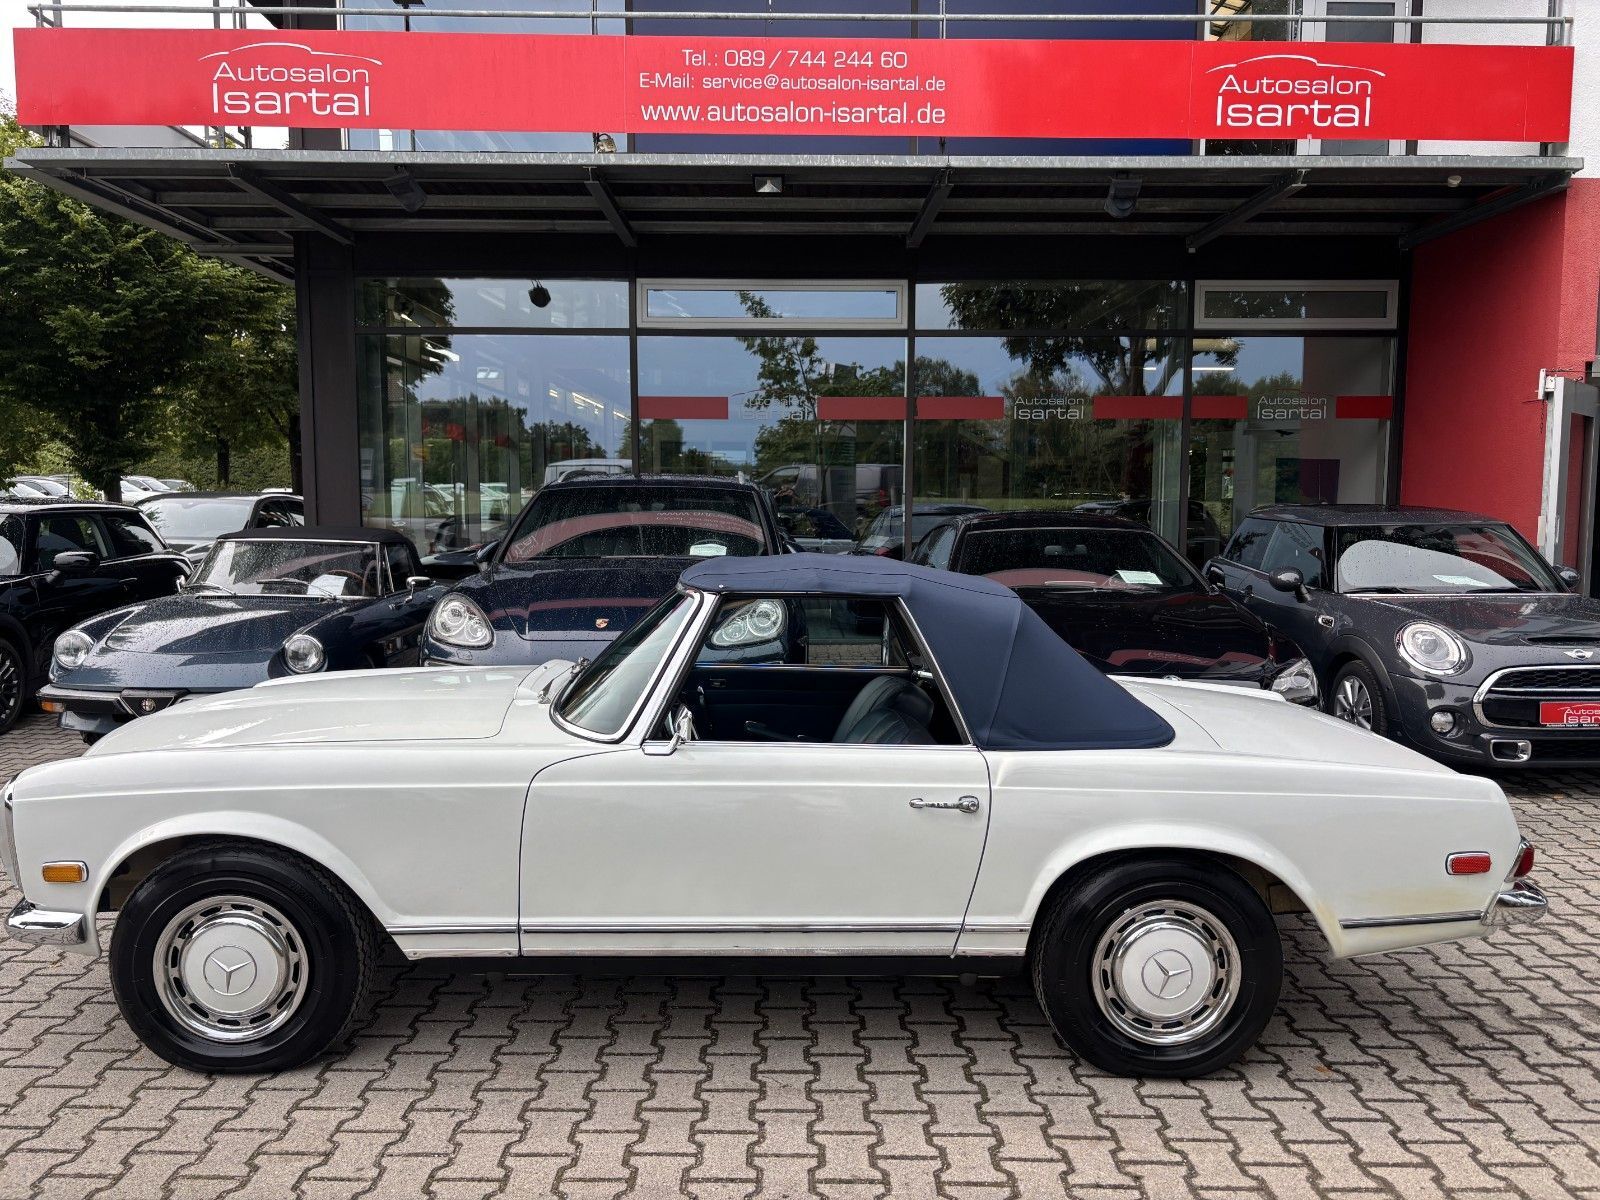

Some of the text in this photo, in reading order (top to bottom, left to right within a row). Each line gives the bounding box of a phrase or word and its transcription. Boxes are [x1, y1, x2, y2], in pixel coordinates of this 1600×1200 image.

[681, 49, 908, 69] Tel.: 089 / 744 244 60
[212, 61, 370, 84] Autosalon
[639, 72, 946, 91] E-Mail: service@autosalon-isartal.de
[1218, 74, 1372, 95] Autosalon
[211, 82, 371, 117] Isartal
[640, 100, 946, 125] www.autosalon-isartal.de
[1216, 95, 1372, 127] Isartal
[1014, 396, 1085, 406] Autosalon
[1257, 395, 1328, 405] Autosalon
[1013, 405, 1084, 420] Isartal
[1257, 404, 1328, 420] Isartal
